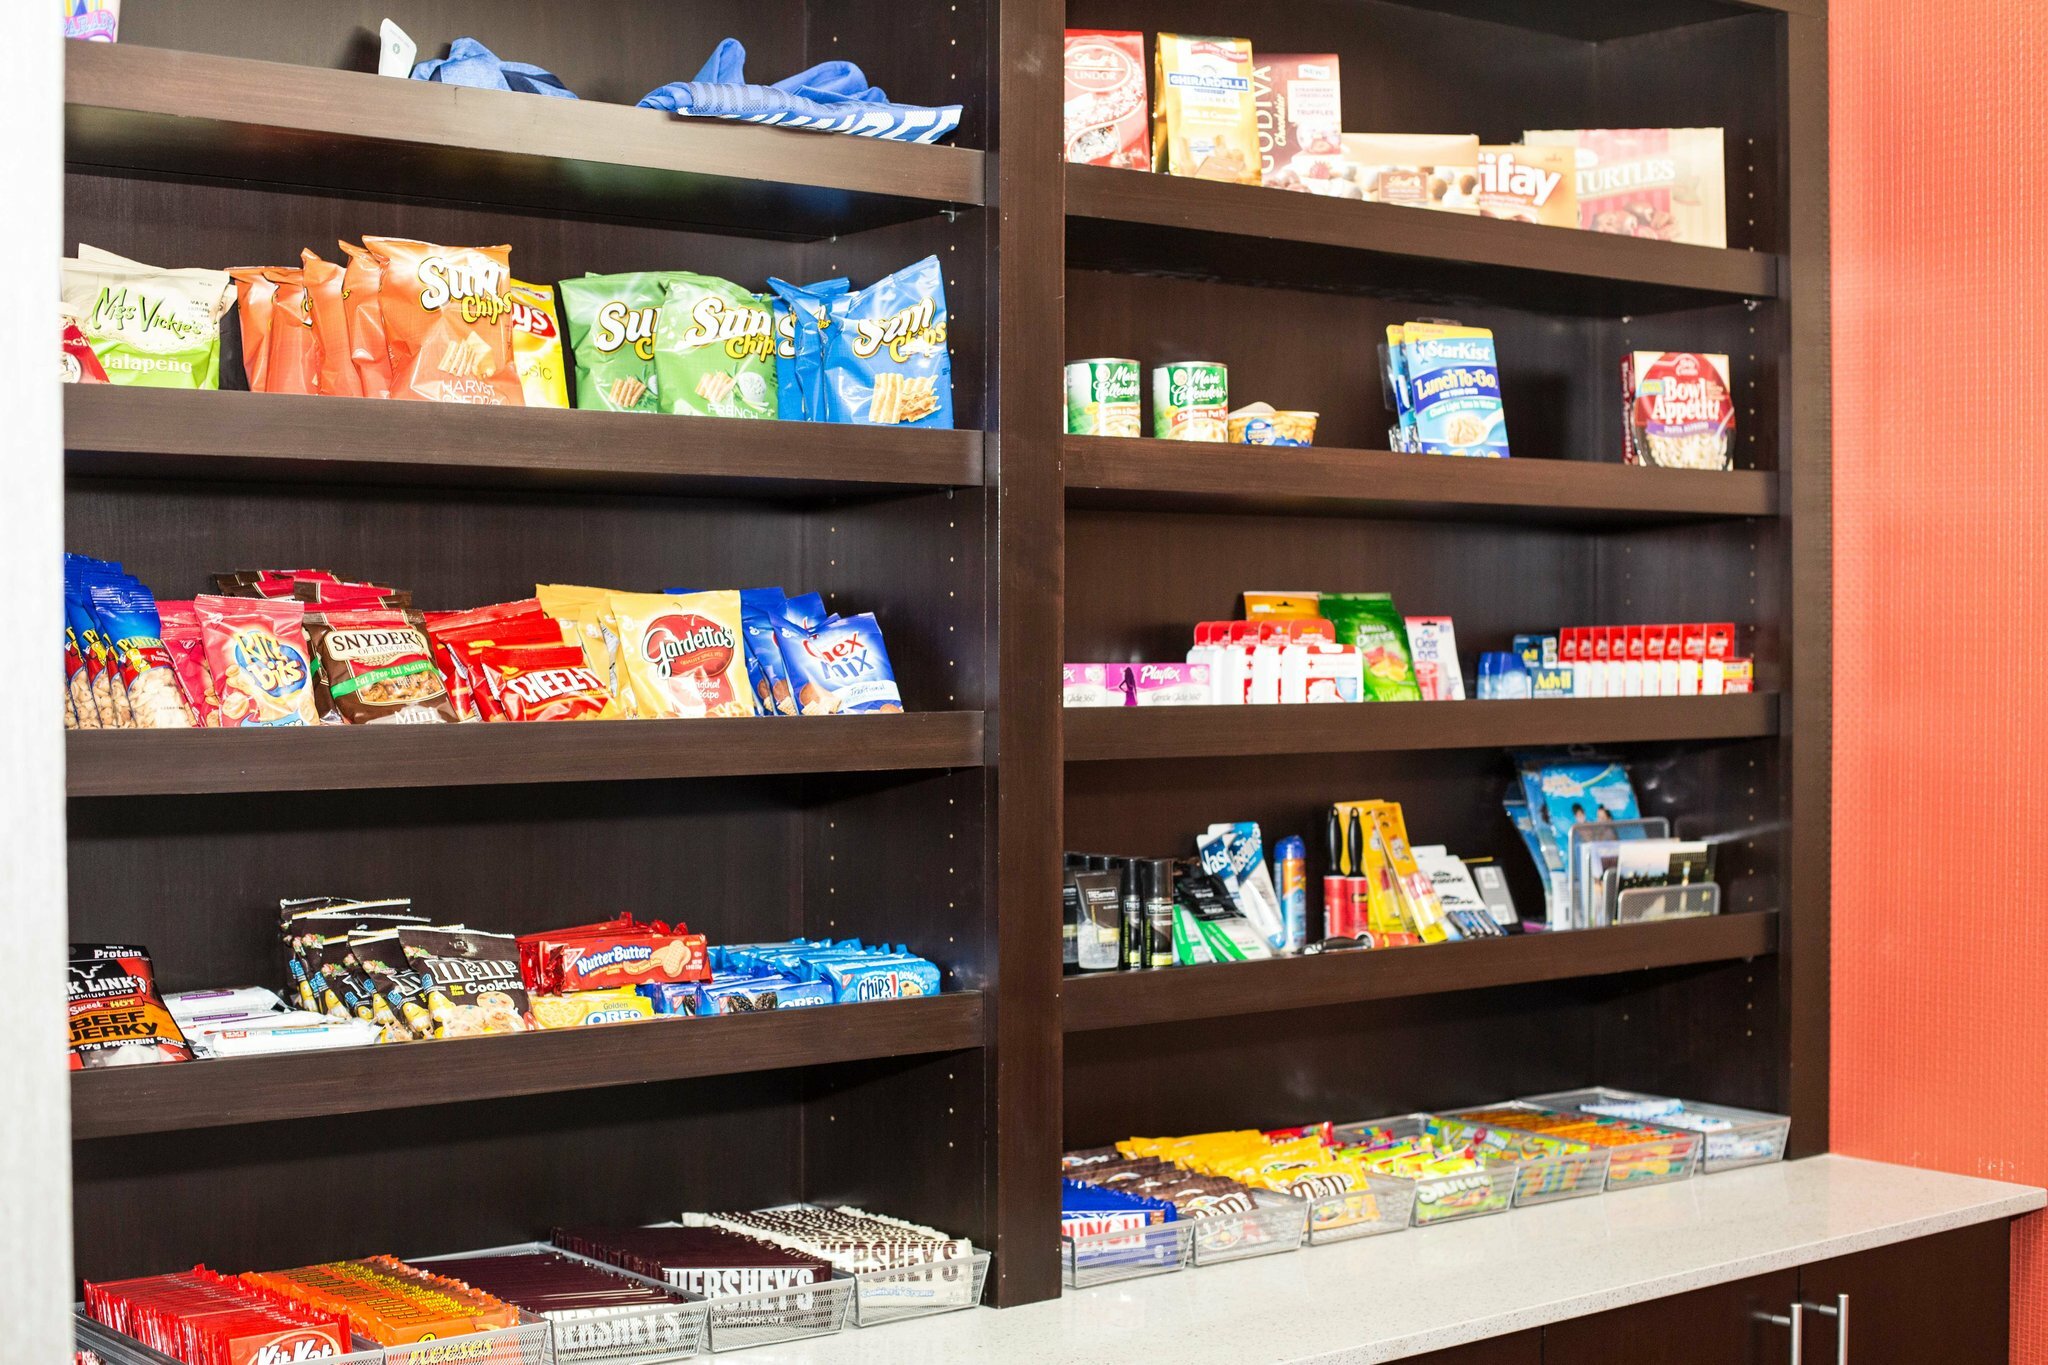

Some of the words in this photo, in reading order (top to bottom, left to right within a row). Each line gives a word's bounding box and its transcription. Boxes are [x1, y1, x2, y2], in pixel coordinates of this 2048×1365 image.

[1074, 70, 1117, 80] LINDOR
[1170, 75, 1246, 90] GHIRARDELLI
[1253, 66, 1274, 174] GODIVA
[1574, 160, 1676, 195] TURTLES
[418, 257, 499, 311] Sun
[93, 287, 136, 330] Miss
[138, 294, 202, 340] Vickie's
[461, 292, 512, 325] Chips
[594, 301, 662, 353] Su
[682, 297, 772, 346] Sun
[853, 297, 936, 359] Sun
[725, 335, 776, 362] Chip
[890, 321, 948, 363] Chips
[1427, 340, 1490, 361] StarKist
[104, 354, 193, 374] Jalapeño
[1187, 369, 1220, 389] Marie
[1415, 369, 1459, 400] Lunch
[1663, 376, 1706, 401] Bowl
[233, 632, 290, 665] RITZ
[332, 631, 425, 652] SNYDER'S
[372, 644, 414, 654] HANOVER
[642, 621, 735, 680] Gardetto's
[1415, 637, 1438, 649] Clear
[246, 660, 304, 691] bits
[354, 674, 371, 687] Fat
[1141, 665, 1181, 684] Playtex
[1534, 670, 1571, 690] Advil
[395, 706, 436, 724] Mini
[94, 949, 142, 959] Protein
[85, 974, 147, 994] LINK'S
[465, 979, 524, 994] Cookies
[858, 976, 891, 1001] Chips
[69, 1001, 103, 1016] Sweet
[110, 998, 136, 1008] HOT
[603, 1002, 628, 1011] Golden
[69, 1010, 145, 1030] BEEF
[587, 1010, 642, 1025] OREO
[69, 1021, 158, 1043] JERKY
[79, 1043, 102, 1051] 17g
[103, 1037, 154, 1048] PROTEIN
[820, 1240, 959, 1283] HERSHEY'S
[668, 1268, 815, 1312] HERSHEY'S
